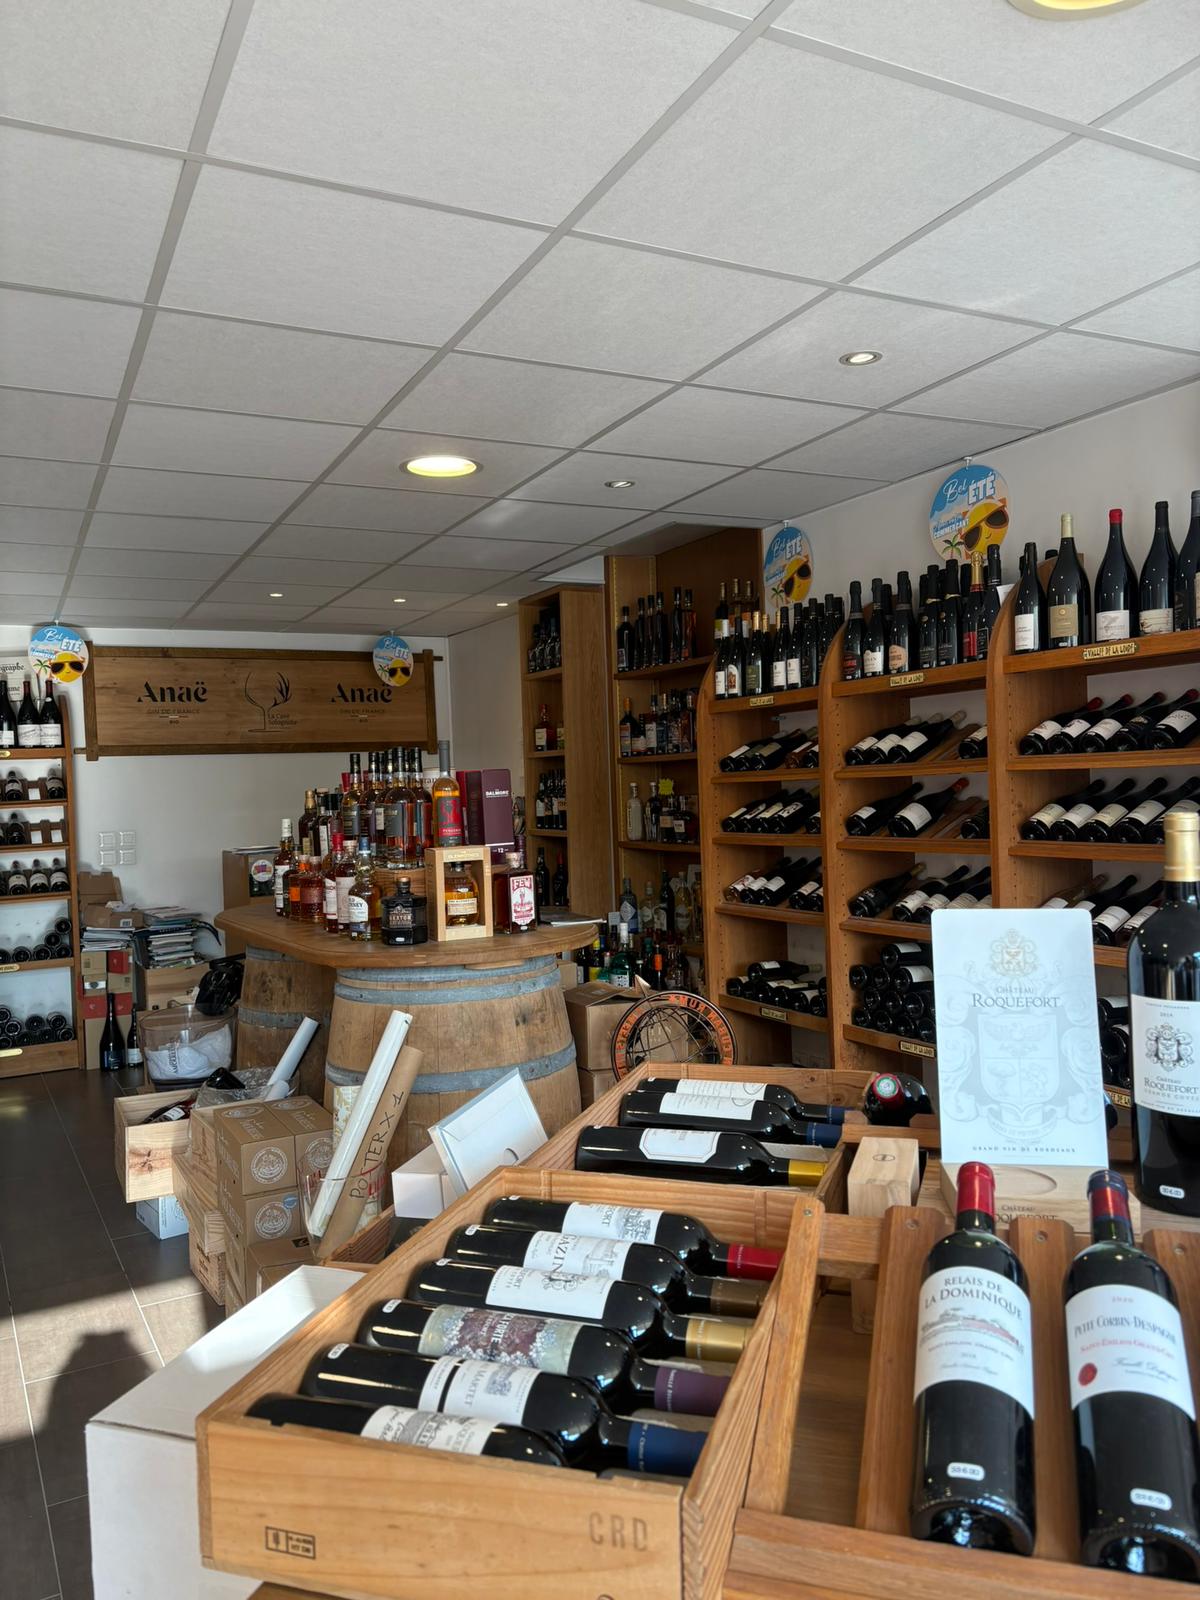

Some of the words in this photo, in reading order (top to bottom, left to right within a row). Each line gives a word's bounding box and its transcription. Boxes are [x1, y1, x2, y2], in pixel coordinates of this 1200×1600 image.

[943, 478, 968, 502] Bel
[969, 471, 996, 506] ÉTÉ
[43, 627, 63, 641] Bel
[61, 637, 82, 652] ÉTÉ
[137, 681, 208, 704] Anaë
[331, 682, 393, 704] Anaë
[485, 789, 510, 798] DALMORE
[512, 877, 533, 890] FEW
[972, 992, 1061, 1009] ROQUEFORT
[1144, 1077, 1199, 1095] ROQUEFORT
[350, 1132, 387, 1199] POSTER
[944, 1276, 983, 1287] RELAIS
[986, 1280, 1003, 1293] DE
[925, 1295, 937, 1310] LA
[940, 1287, 1023, 1321] DOMINIQUE
[589, 1511, 649, 1552] CRD
